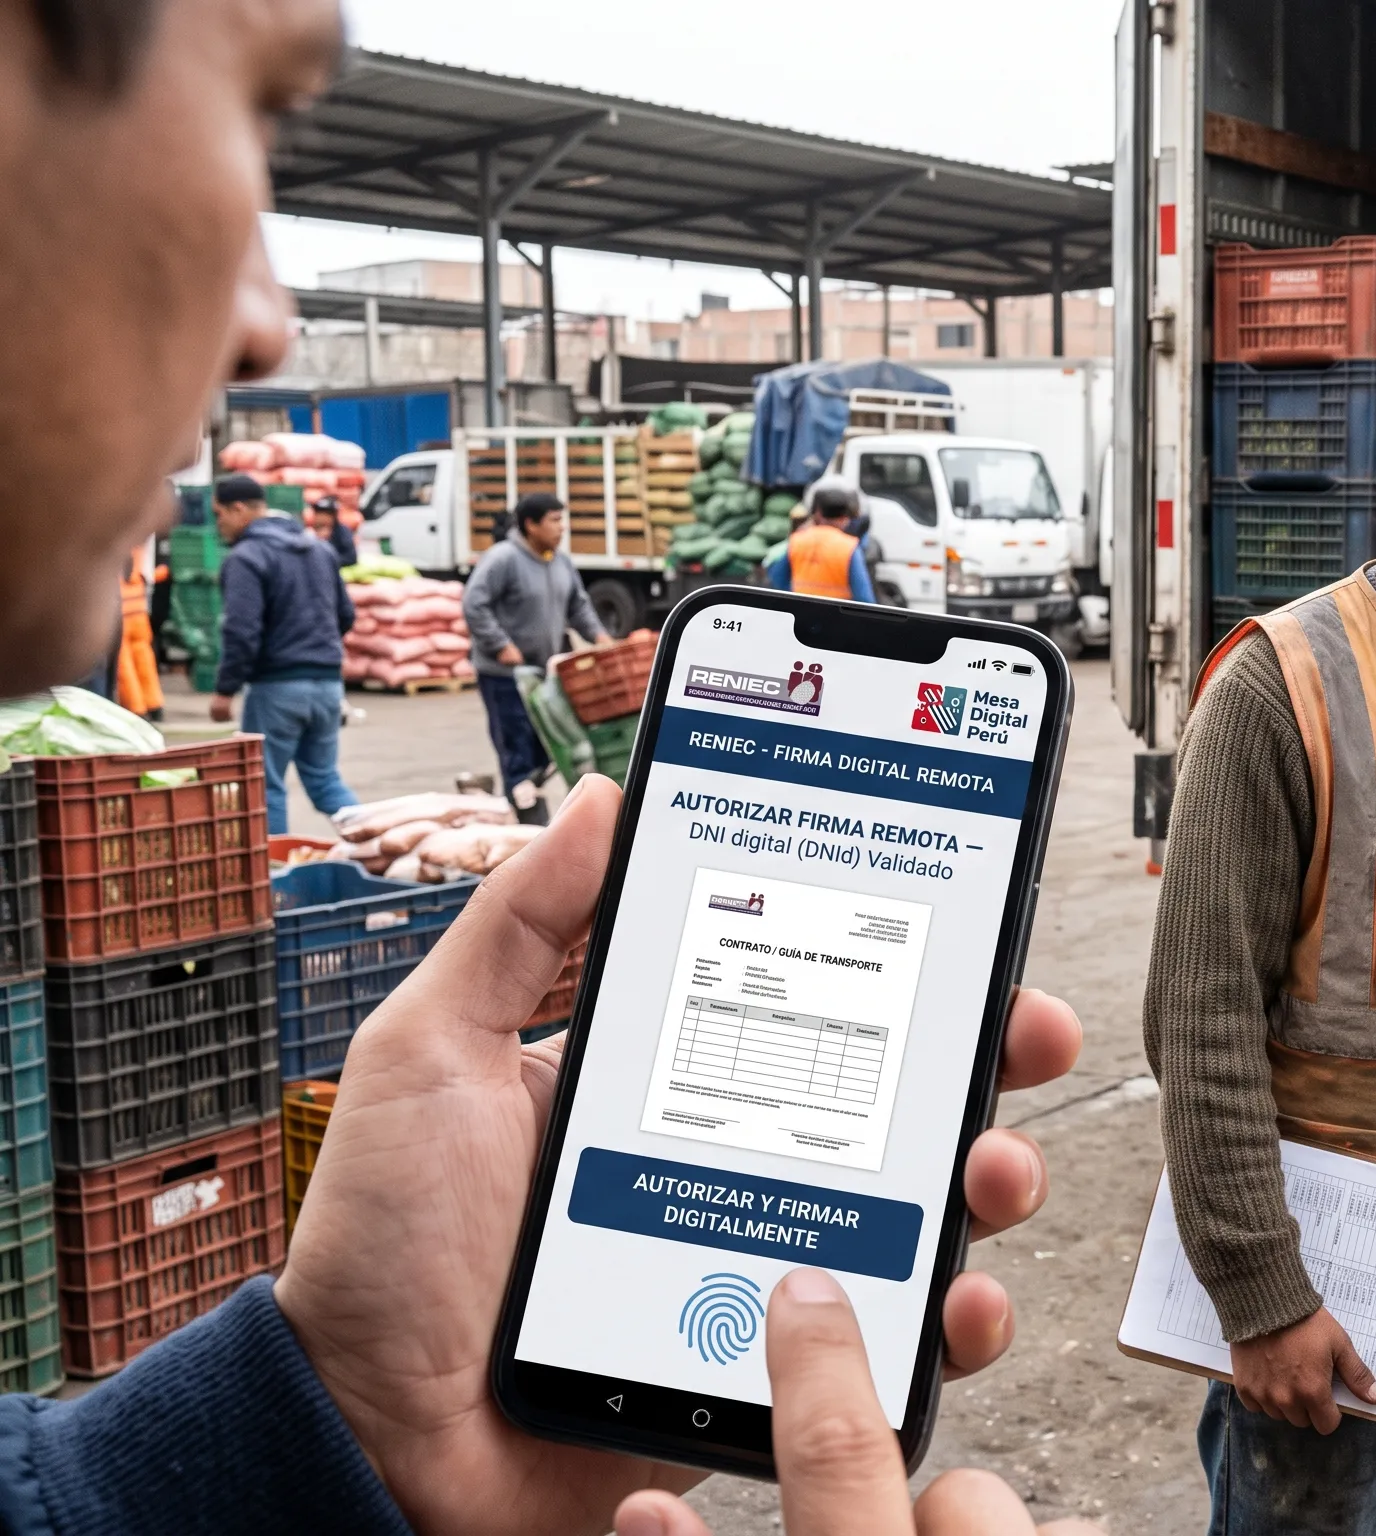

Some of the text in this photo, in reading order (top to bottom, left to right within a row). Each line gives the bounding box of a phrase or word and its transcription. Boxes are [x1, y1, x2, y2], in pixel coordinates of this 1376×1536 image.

[713, 618, 742, 632] 9:41
[691, 670, 780, 695] RENIEC
[973, 690, 1019, 709] Mesa
[967, 725, 1008, 744] Perú
[970, 707, 1028, 728] Digital
[689, 731, 756, 755] RENIEC
[774, 744, 832, 768] FIRMA
[838, 755, 910, 780] DIGITAL
[917, 767, 994, 793] REMOTA
[670, 791, 792, 826] AUTORIZAR
[798, 811, 864, 838] FIRMA
[871, 822, 958, 853] REMOTA
[689, 822, 953, 880] DNI digital (DNId) Validado
[719, 938, 882, 972] CONTRATO / GUÍA DE TRANSPORTE
[633, 1173, 859, 1228] AUTORIZAR Y FIRMAR
[664, 1205, 819, 1249] DIGITALMENTE
